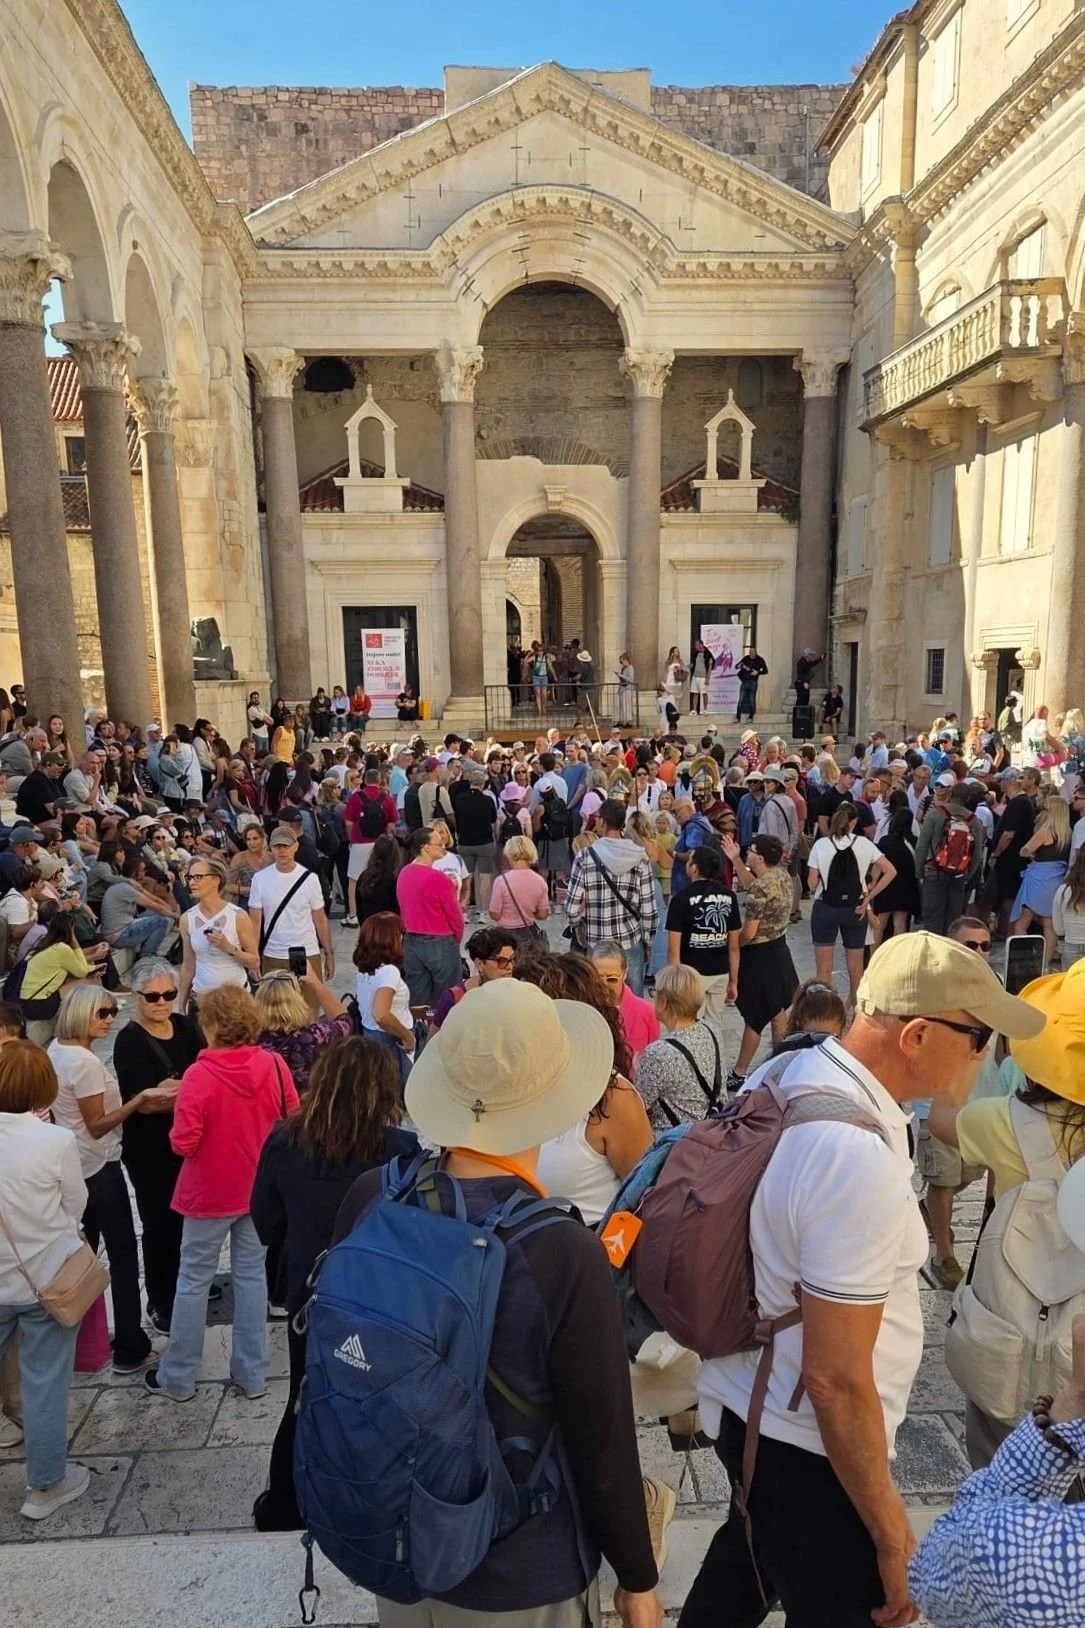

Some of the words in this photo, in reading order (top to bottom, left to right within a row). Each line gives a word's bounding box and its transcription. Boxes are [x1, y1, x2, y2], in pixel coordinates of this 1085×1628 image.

[689, 894, 732, 905] MAMI
[691, 932, 728, 942] BEACH
[333, 1348, 373, 1372] GREGORY
